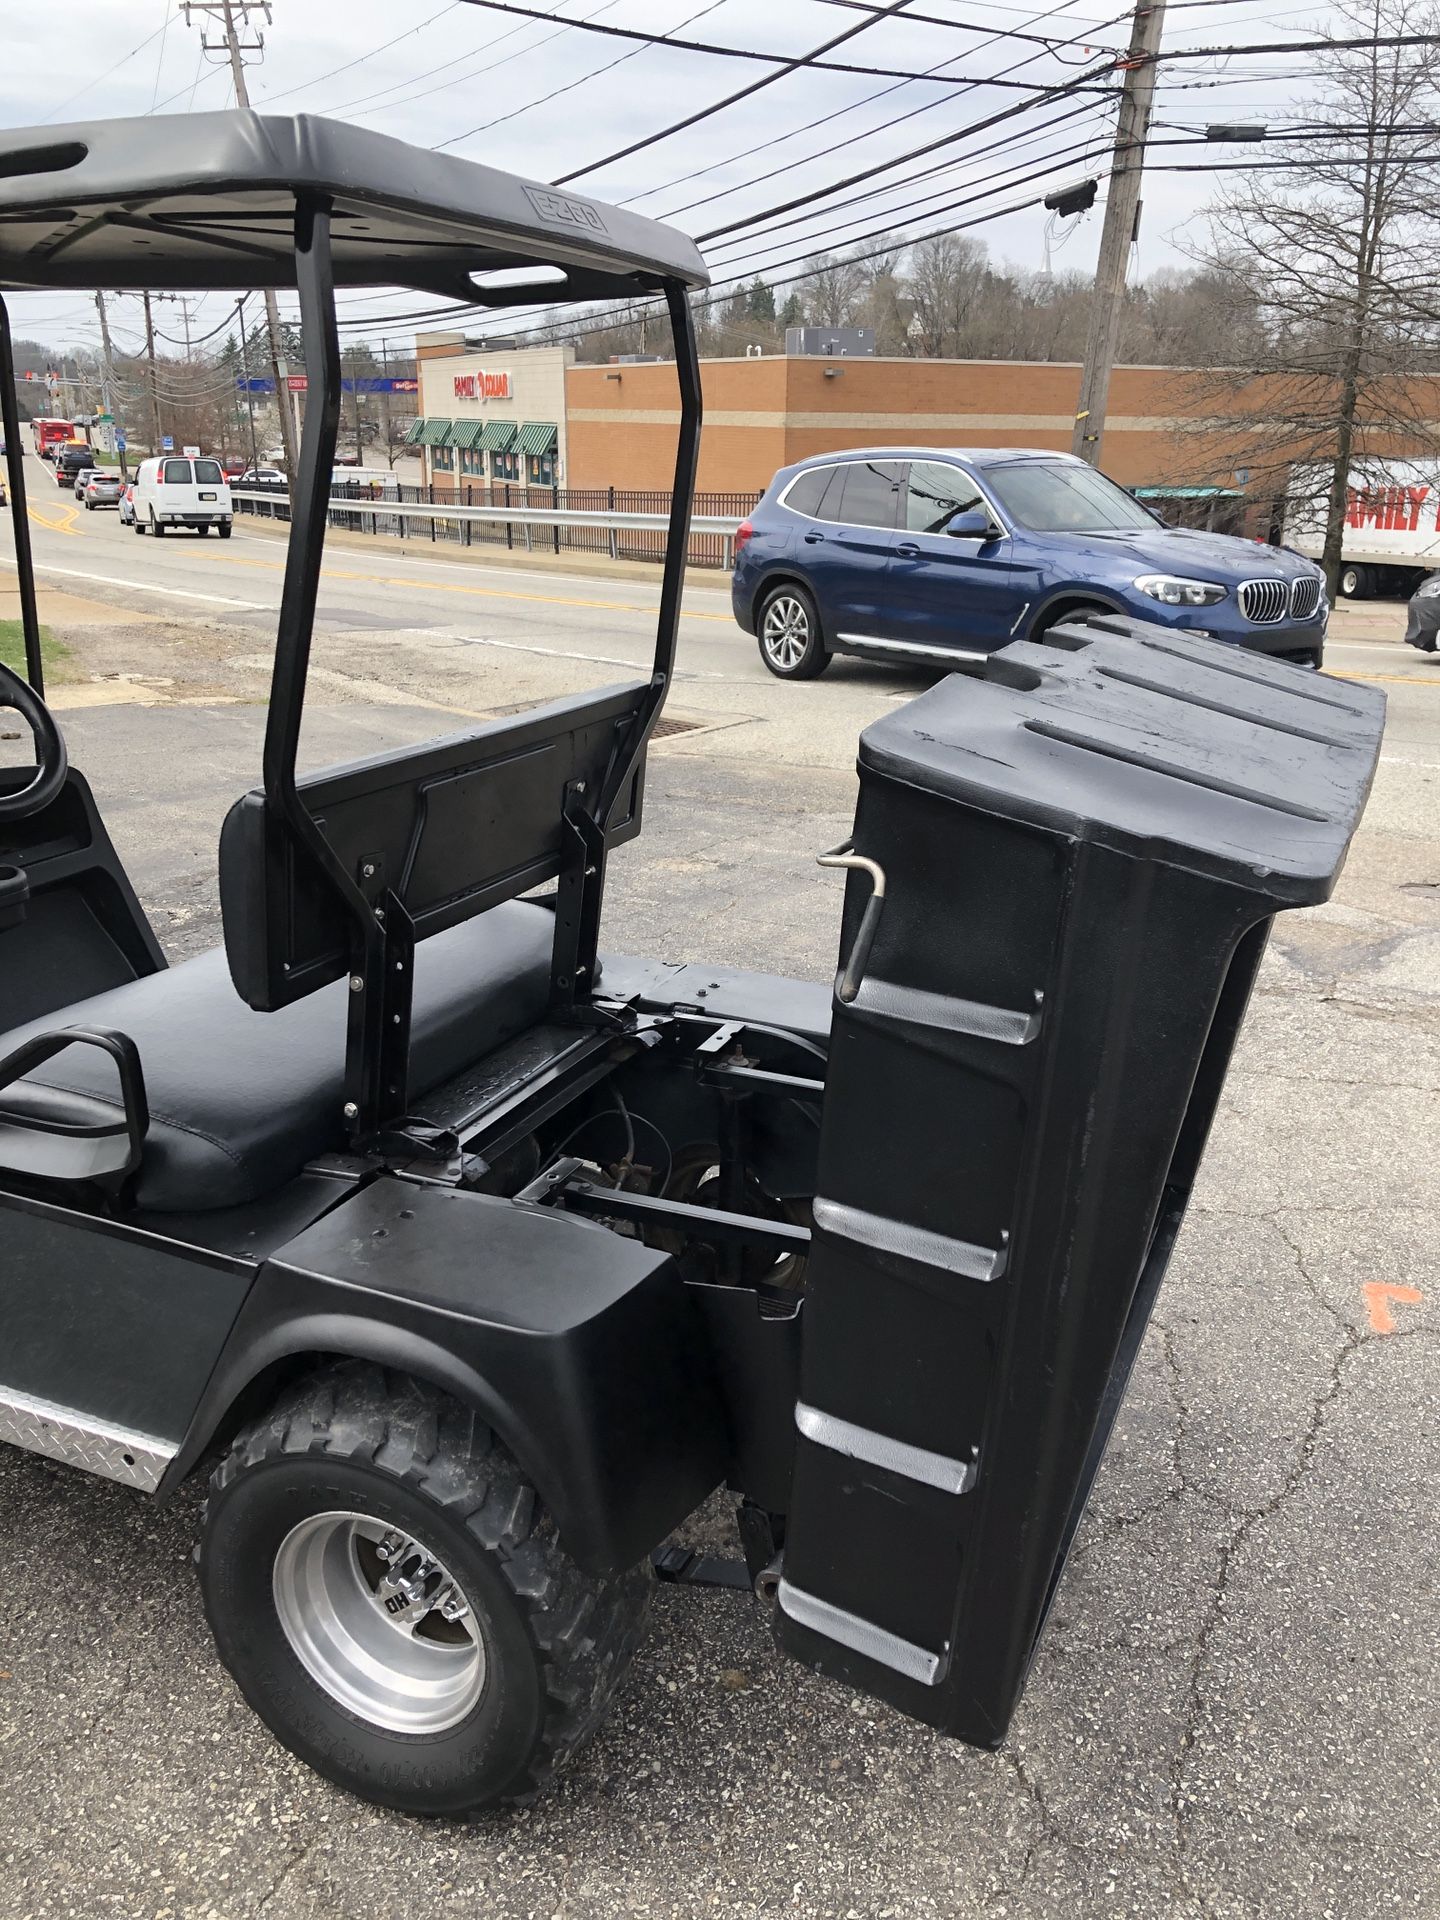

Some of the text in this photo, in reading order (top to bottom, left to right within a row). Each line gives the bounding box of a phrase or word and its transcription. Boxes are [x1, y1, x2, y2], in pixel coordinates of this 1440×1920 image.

[454, 373, 509, 397] FAMILY DOLLAR
[1330, 484, 1430, 531] AMILY
[384, 1591, 410, 1614] HD
